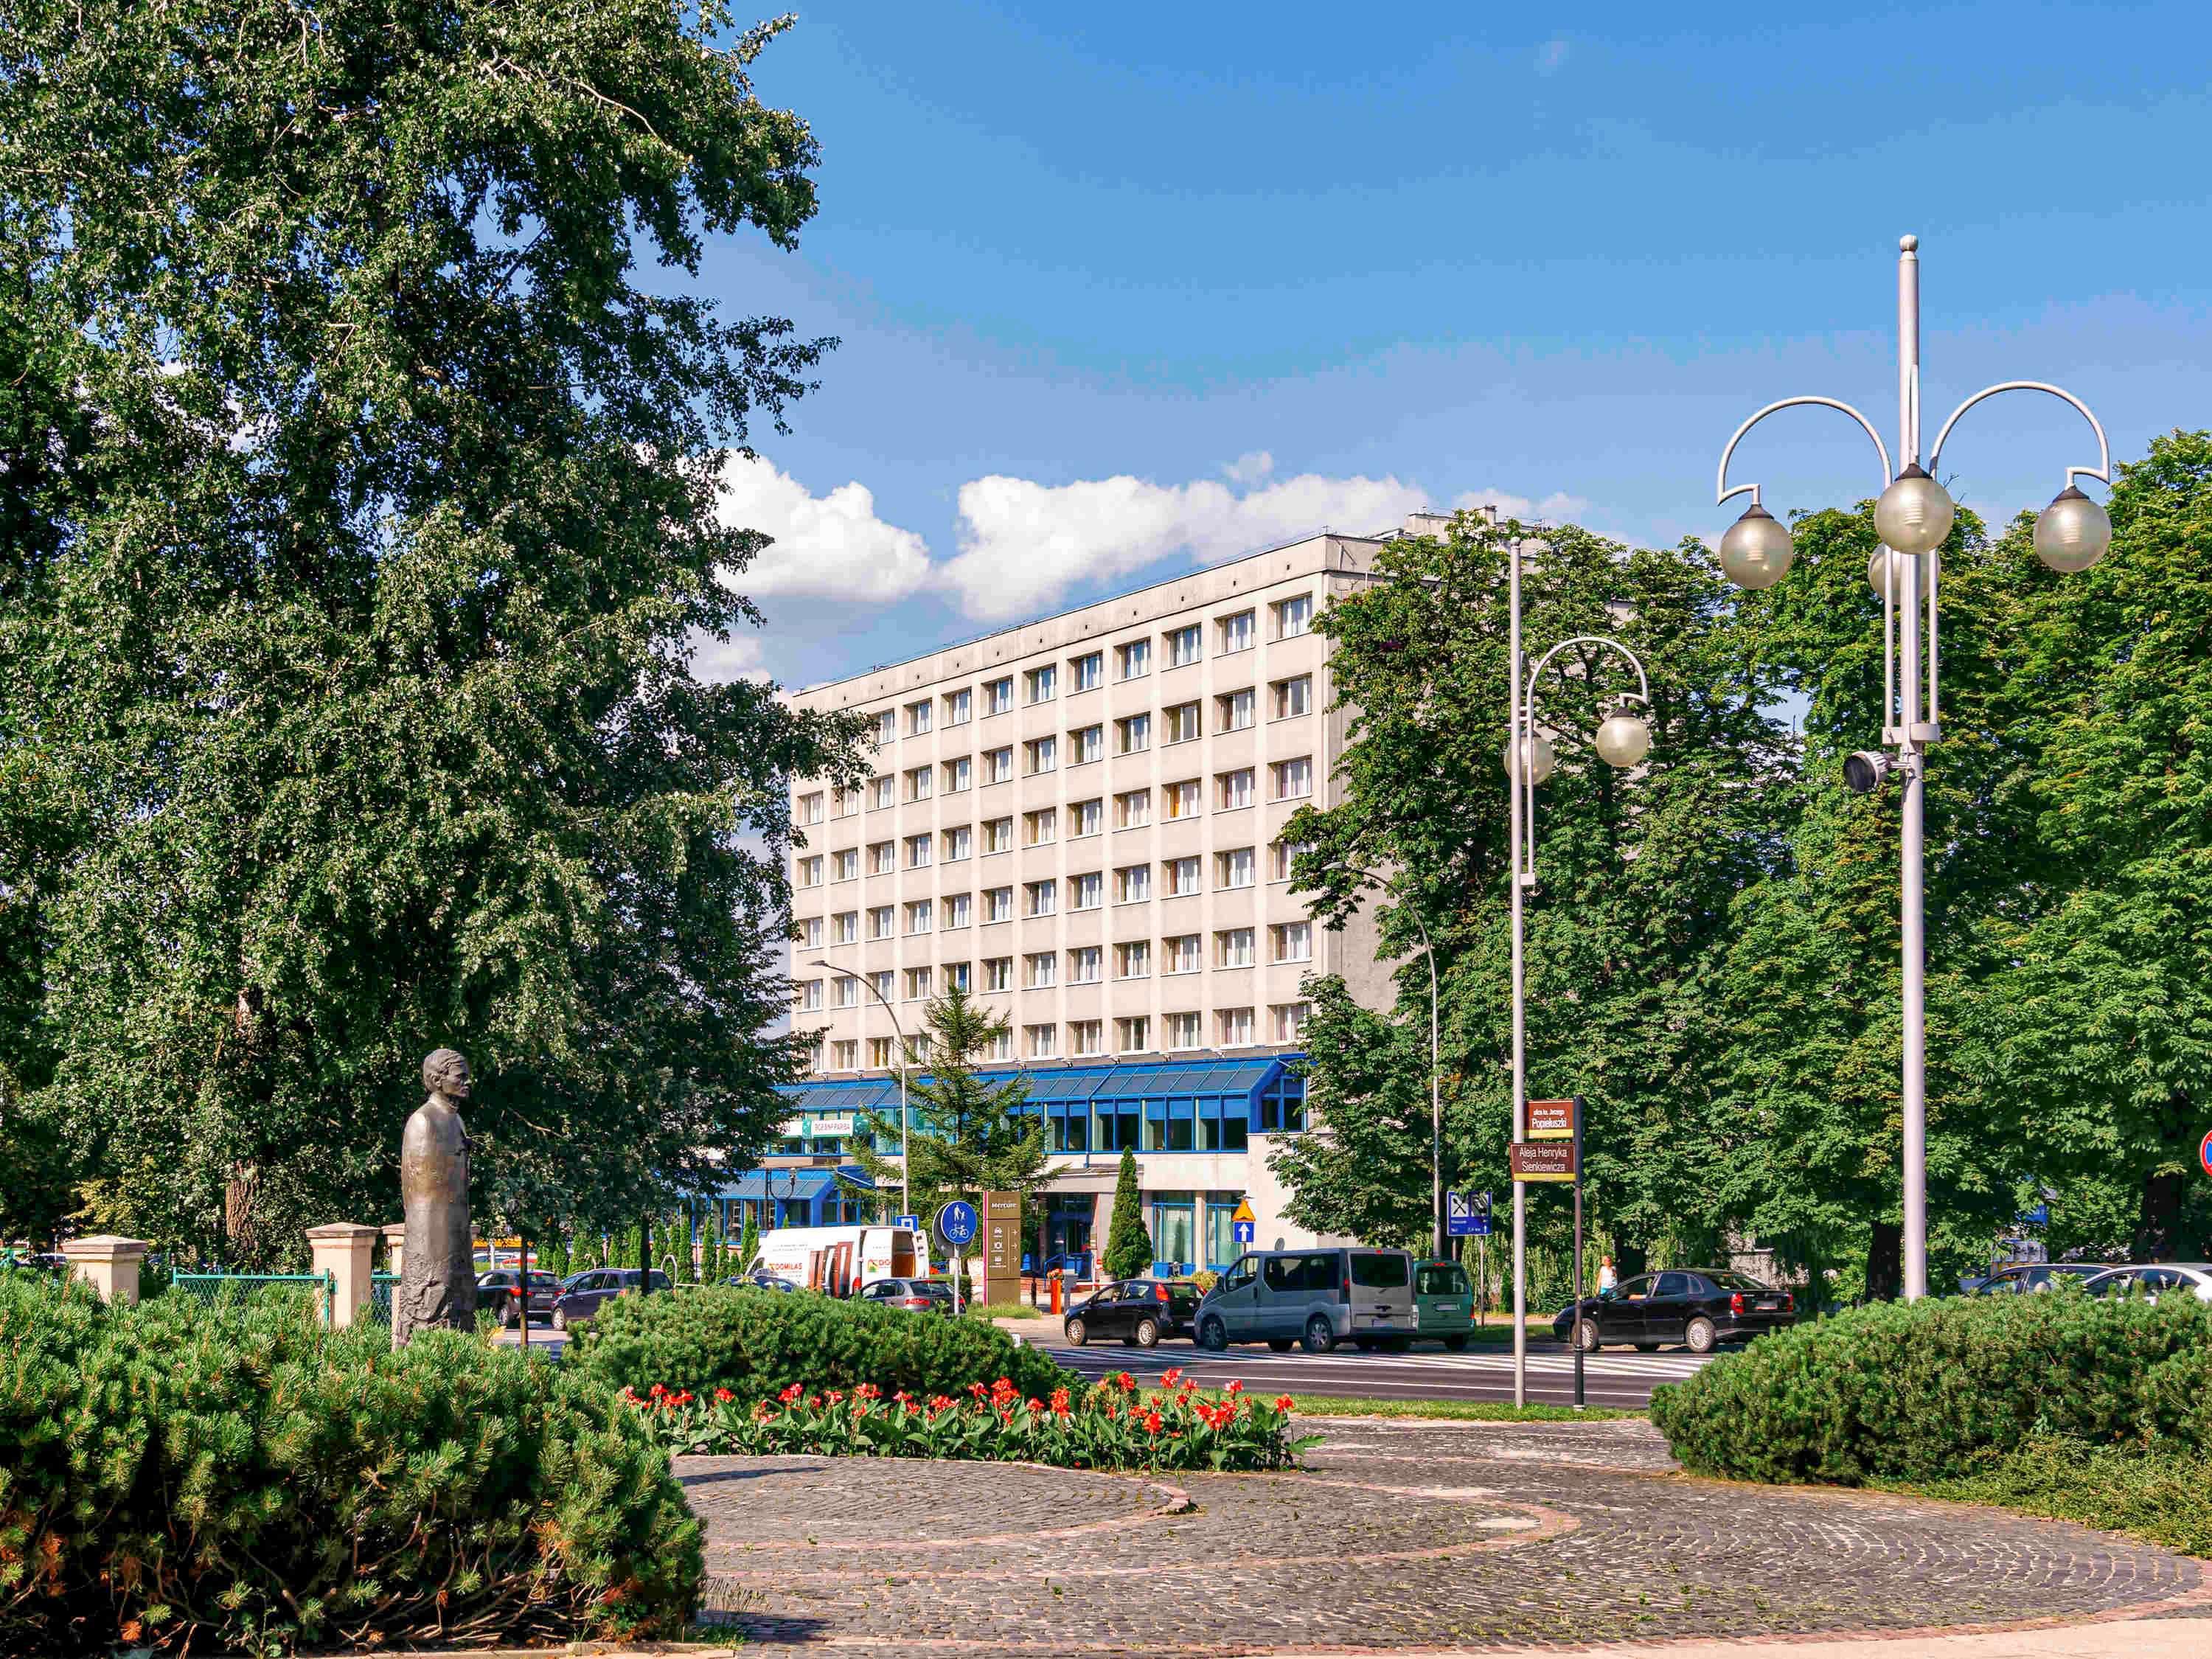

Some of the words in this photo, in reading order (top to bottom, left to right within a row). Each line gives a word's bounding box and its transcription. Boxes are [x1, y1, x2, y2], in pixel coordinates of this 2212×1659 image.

[1519, 1147, 1537, 1159] Aleja
[1538, 1147, 1568, 1159] Henryka
[1522, 1161, 1565, 1172] Sienkiewicza
